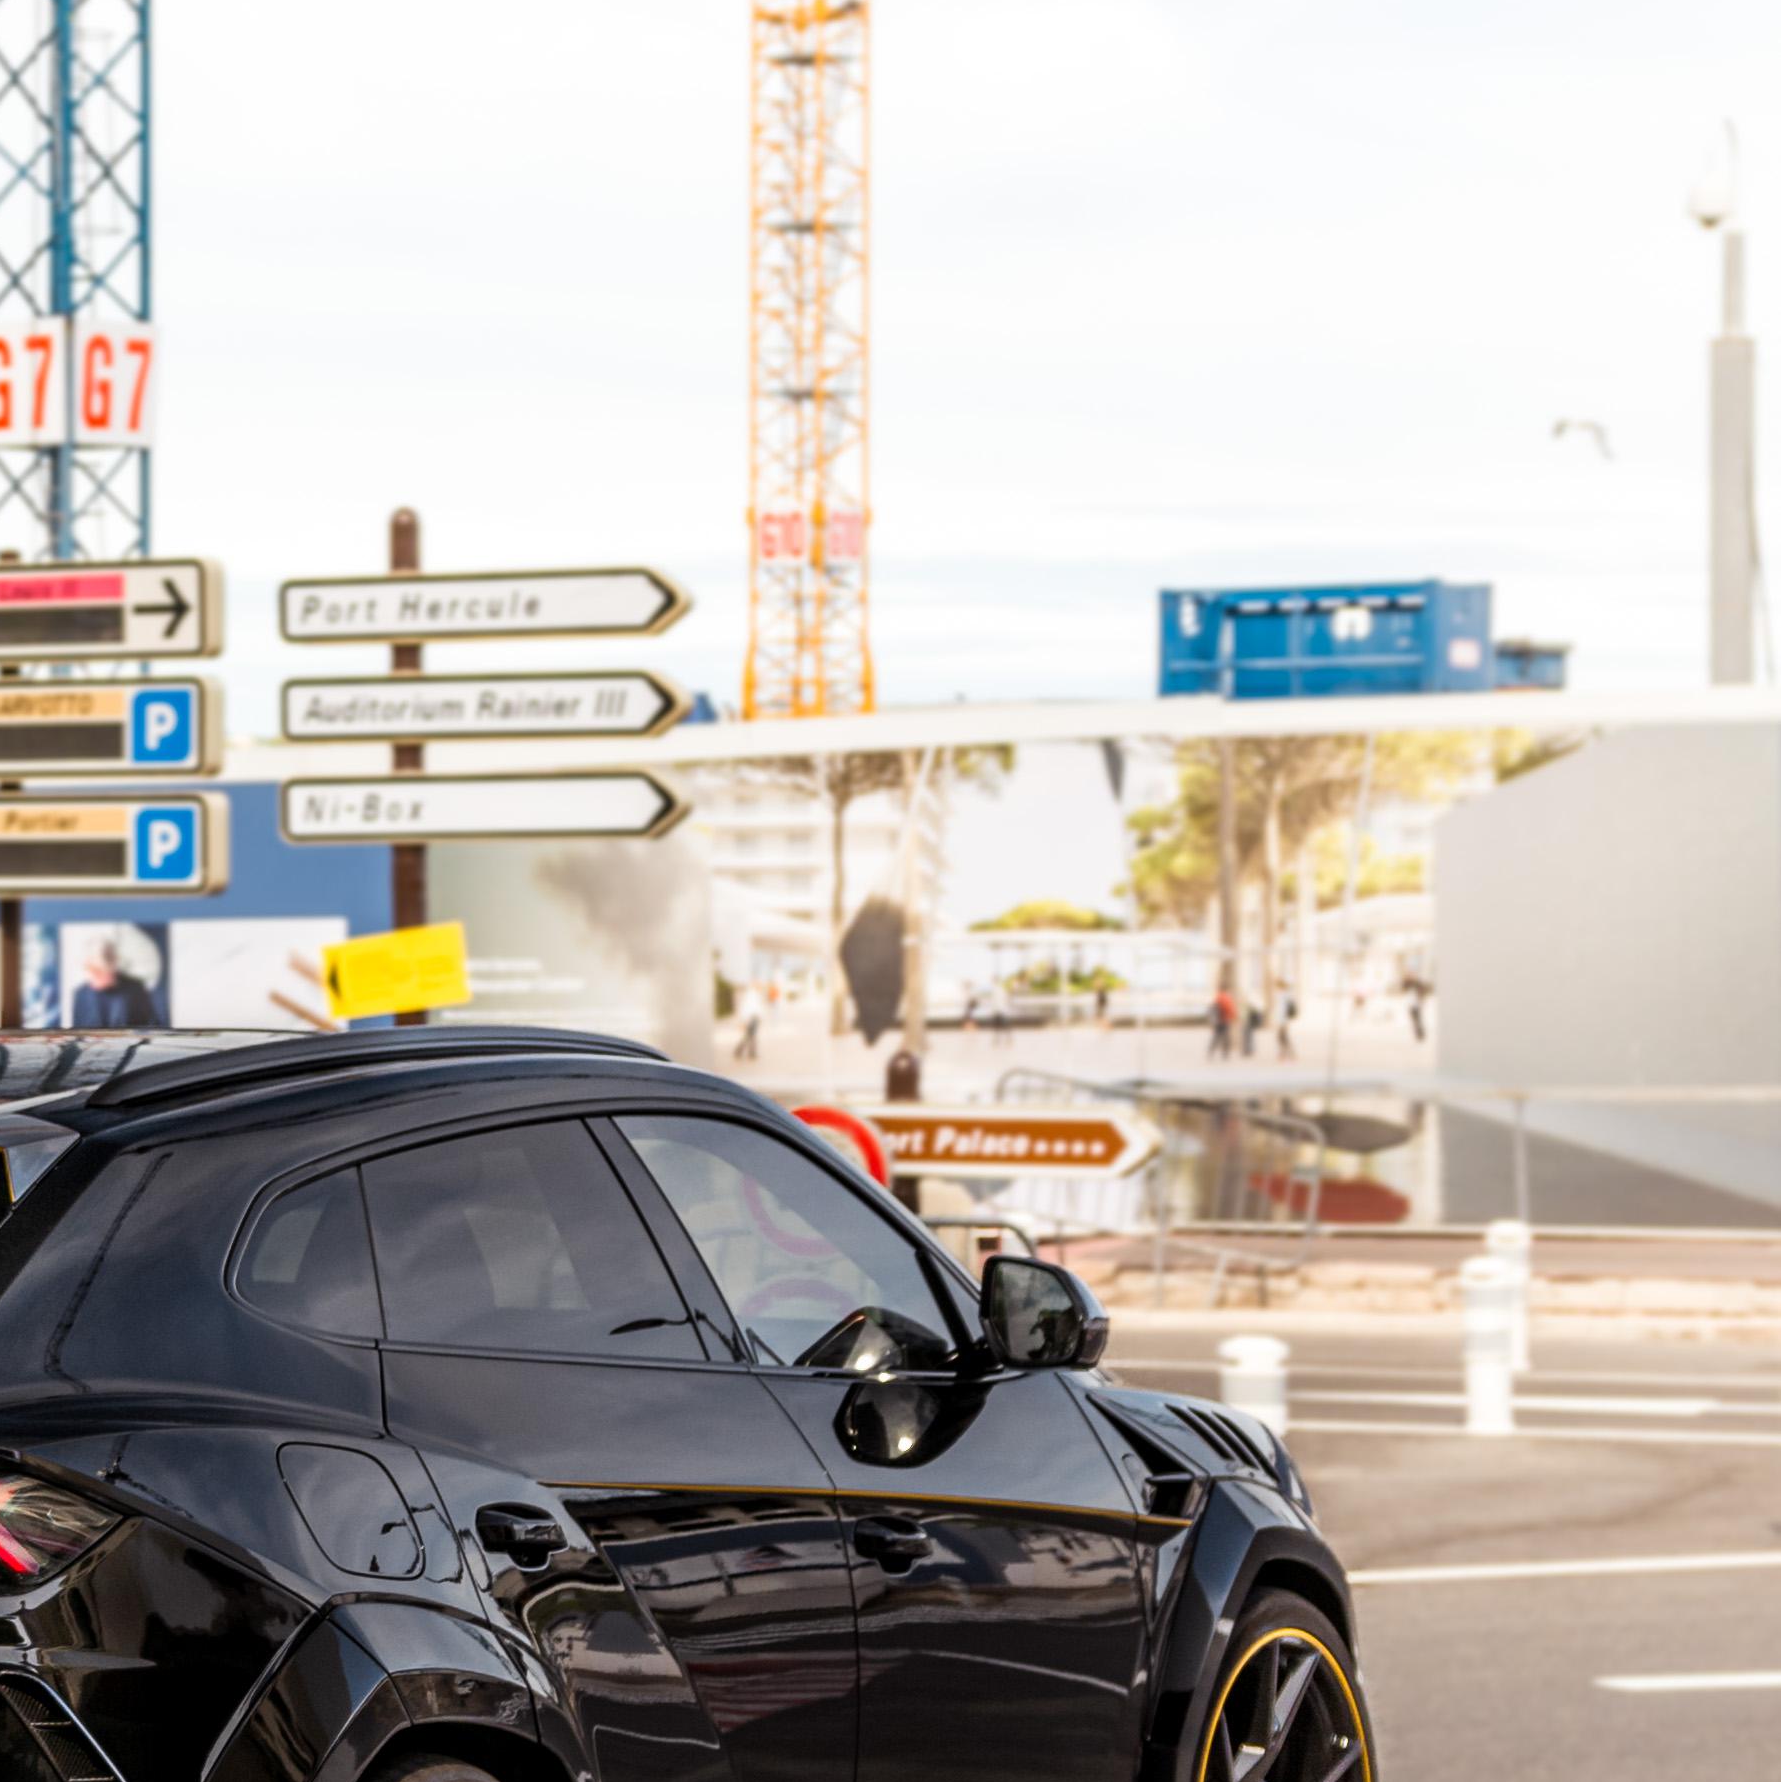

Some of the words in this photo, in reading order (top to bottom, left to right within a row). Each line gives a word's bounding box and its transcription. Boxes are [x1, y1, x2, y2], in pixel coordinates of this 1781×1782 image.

[82, 335, 153, 431] G7
[299, 594, 378, 625] Port
[398, 589, 542, 621] Hercule
[303, 693, 464, 724] Auditorium
[475, 689, 581, 718] Rainier
[592, 687, 629, 718] III
[144, 701, 179, 752] P
[3, 811, 79, 832] Portier
[303, 793, 424, 823] Ni-Box
[147, 819, 182, 870] P
[882, 1128, 926, 1154] ort
[933, 1125, 1031, 1157] Palace
